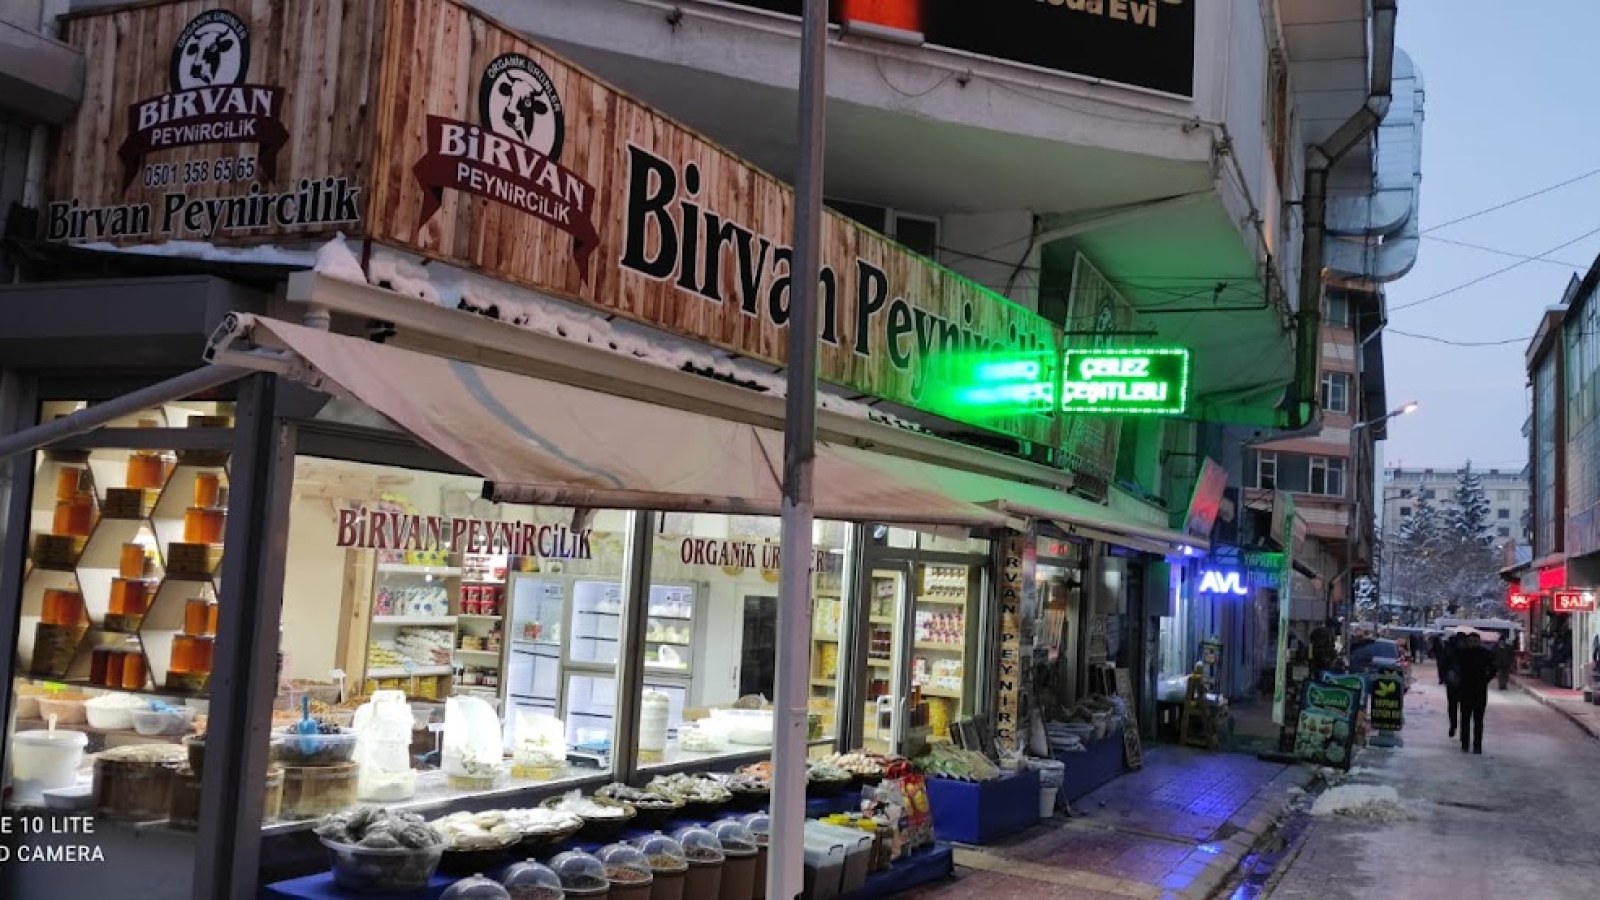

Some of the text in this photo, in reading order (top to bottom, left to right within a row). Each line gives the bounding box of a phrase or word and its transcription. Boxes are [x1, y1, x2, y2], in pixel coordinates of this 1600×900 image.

[145, 157, 255, 186] 0501 358 65 65
[49, 176, 361, 241] Birvan Peynircilik
[620, 143, 838, 346] Birvan
